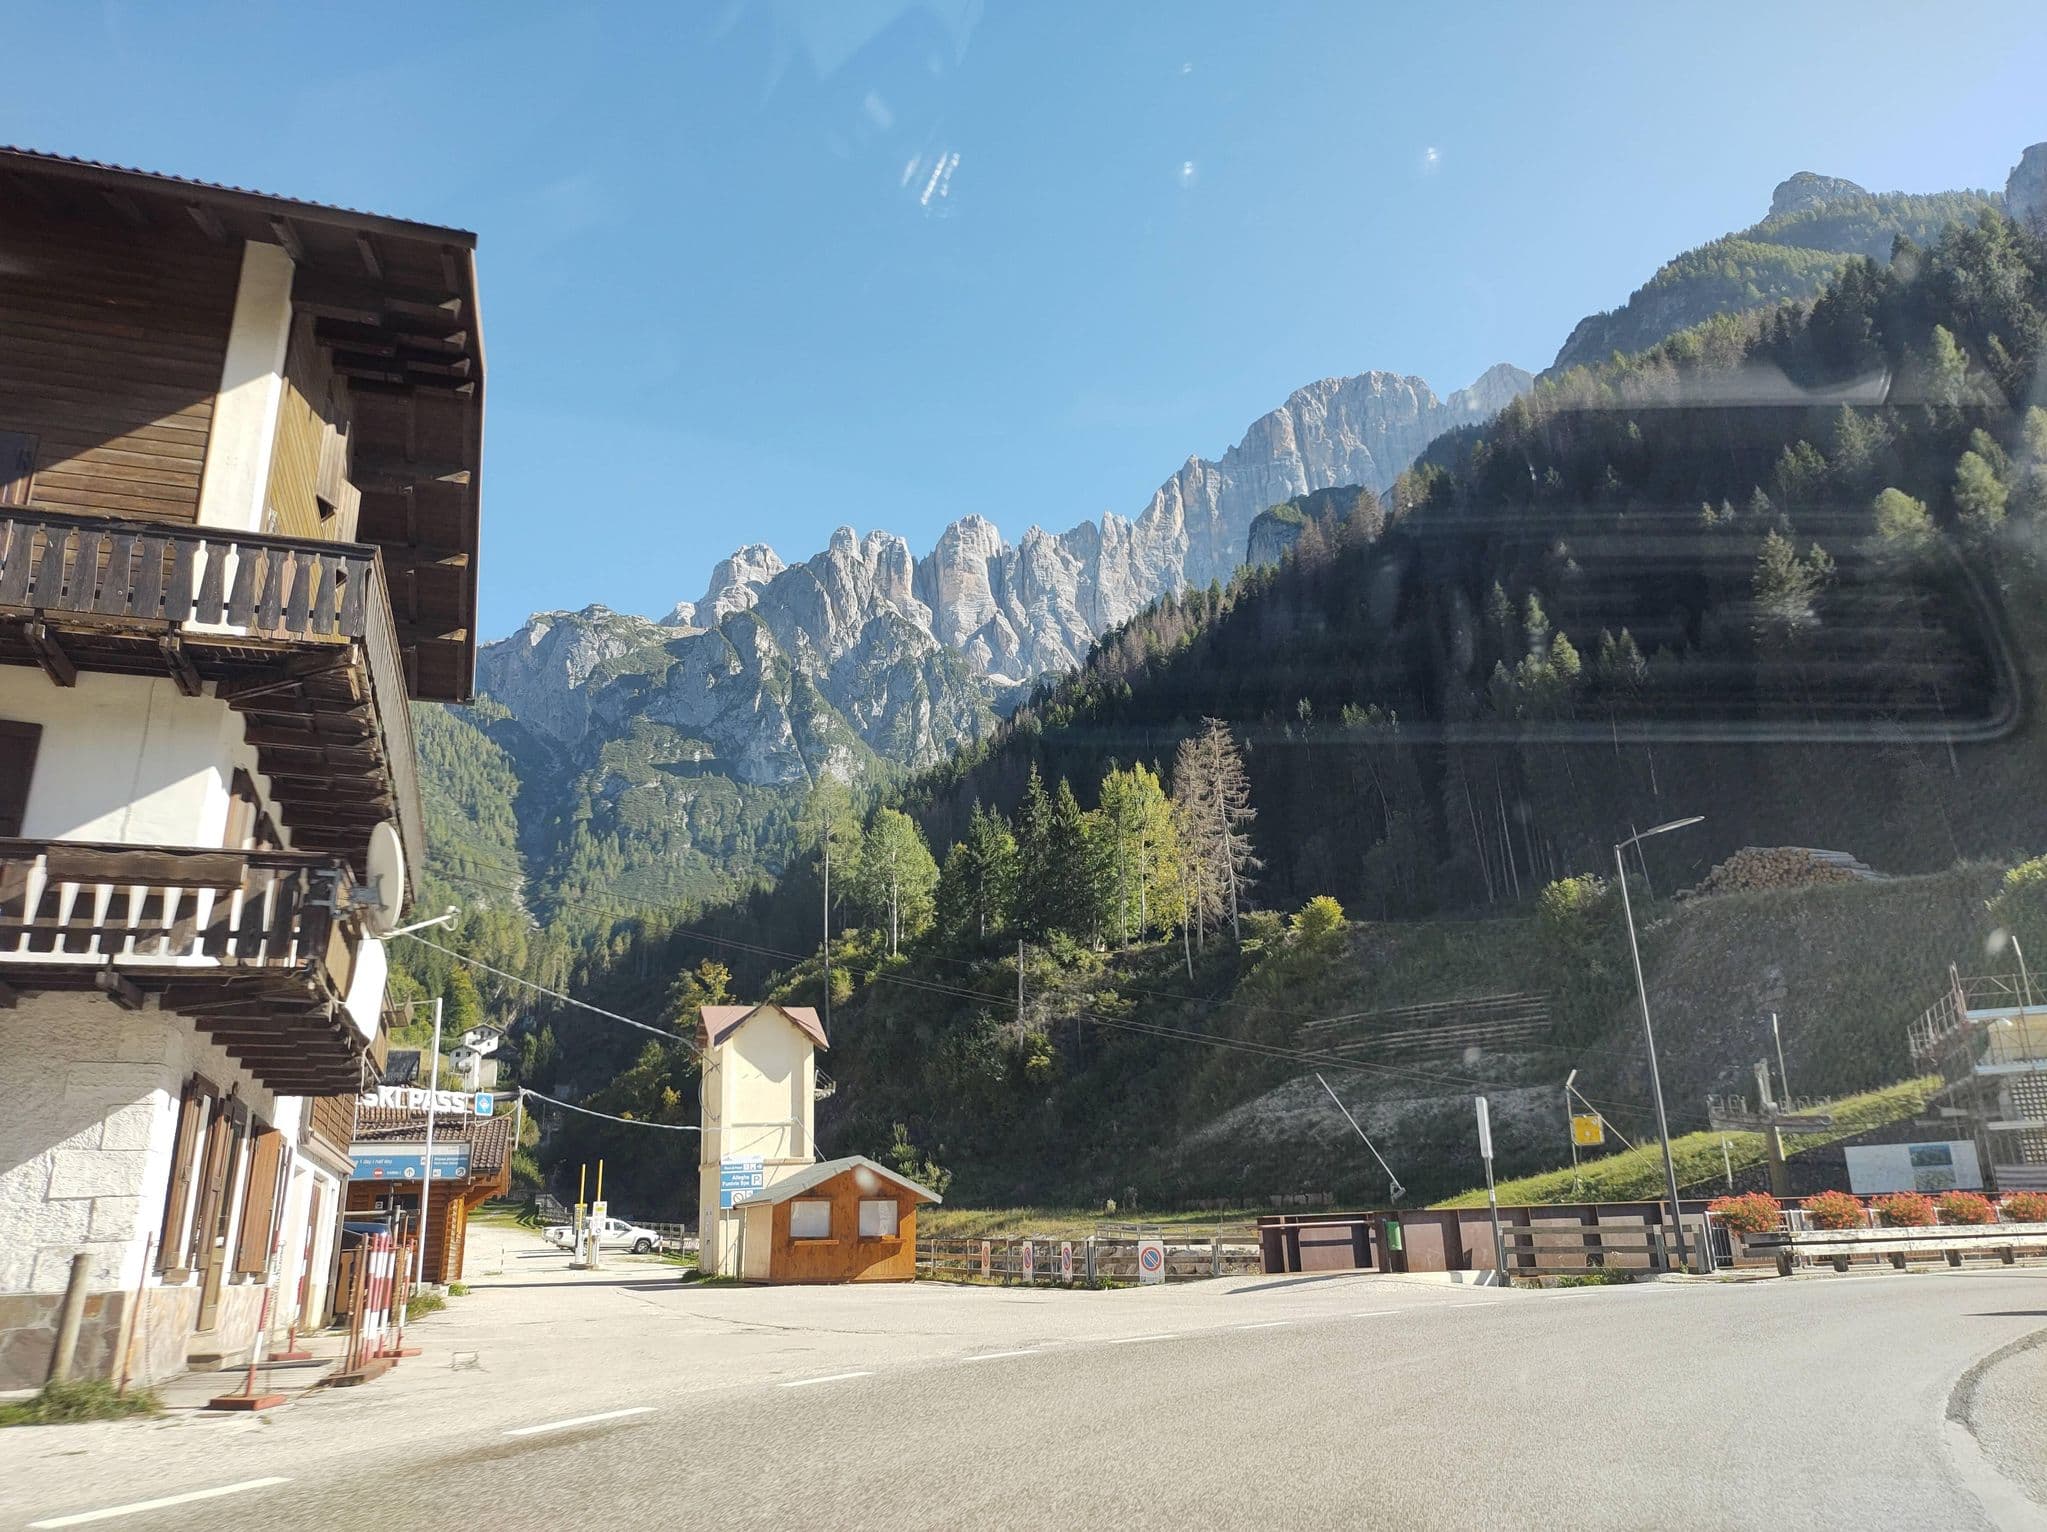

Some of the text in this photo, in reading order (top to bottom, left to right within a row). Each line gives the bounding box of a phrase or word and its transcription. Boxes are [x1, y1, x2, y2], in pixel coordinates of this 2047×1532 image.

[361, 1086, 465, 1113] SKI PASS
[753, 1175, 760, 1184] P
